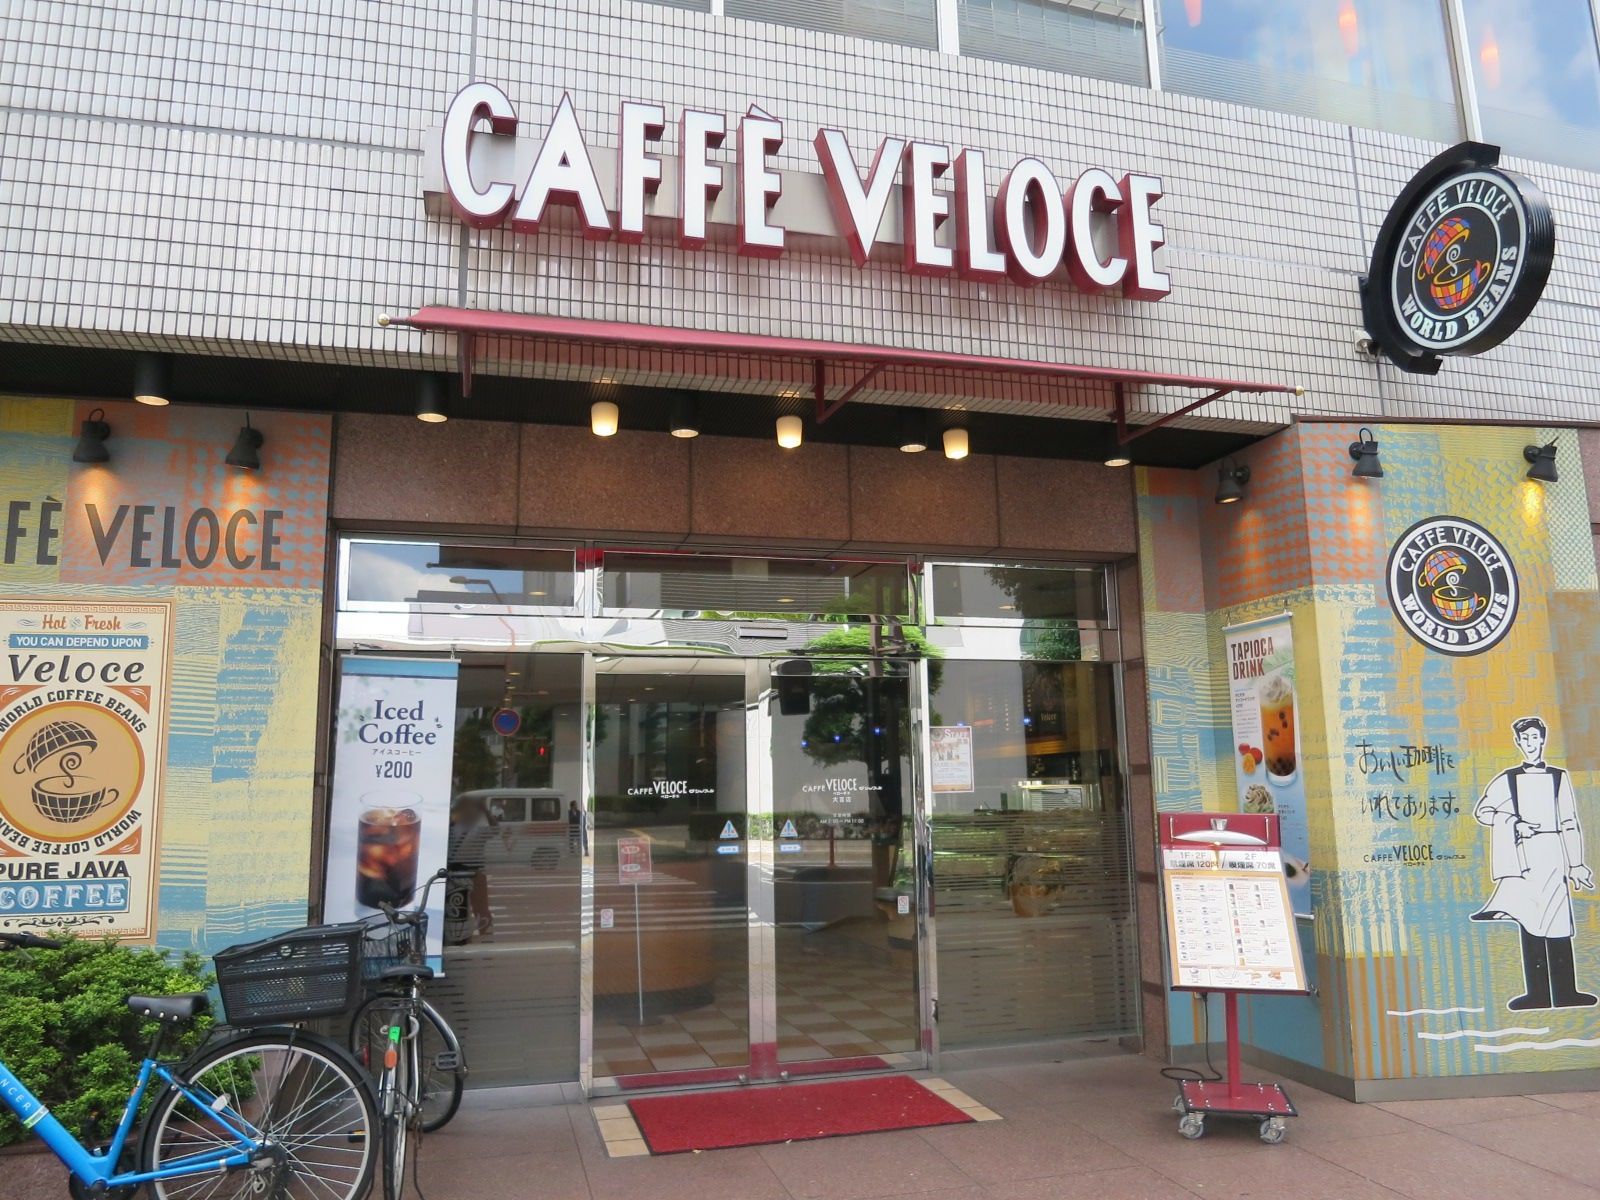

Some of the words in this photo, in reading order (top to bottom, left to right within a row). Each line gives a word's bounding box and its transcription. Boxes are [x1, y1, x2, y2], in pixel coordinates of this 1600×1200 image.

[442, 82, 786, 258] CAFFÈ
[815, 127, 1171, 300] VELOCE
[1455, 180, 1513, 221] VELOCE
[1401, 293, 1458, 341] WORLD
[1465, 245, 1518, 331] BEANS
[84, 503, 284, 571] VELOCE
[1453, 528, 1503, 572] VELOCE
[42, 614, 67, 630] Hot
[84, 614, 122, 631] Fresh
[1402, 593, 1459, 644] WORLD
[1465, 593, 1508, 643] BEANS
[16, 636, 38, 646] YOU
[40, 636, 64, 647] CAN
[66, 637, 109, 647] DEPEND
[111, 638, 142, 648] UPON
[1231, 637, 1274, 661] TAPIOCA
[8, 654, 145, 684] Veloce
[1233, 658, 1265, 680] DRINK
[0, 695, 43, 733] WORLD
[47, 689, 104, 704] COFFEE
[105, 697, 147, 733] BEANS
[374, 699, 424, 721] Iced
[358, 723, 437, 745] Coffee
[372, 748, 422, 757] アイスコーヒー
[375, 760, 413, 779] ¥200
[653, 780, 687, 794] VELOCE
[825, 778, 858, 792] VELOCE
[95, 809, 142, 848] WORLD
[31, 841, 90, 855] COFFEE
[1392, 844, 1434, 861] VELOCE
[67, 860, 130, 878] JAVA
[0, 883, 126, 910] COFFEE
